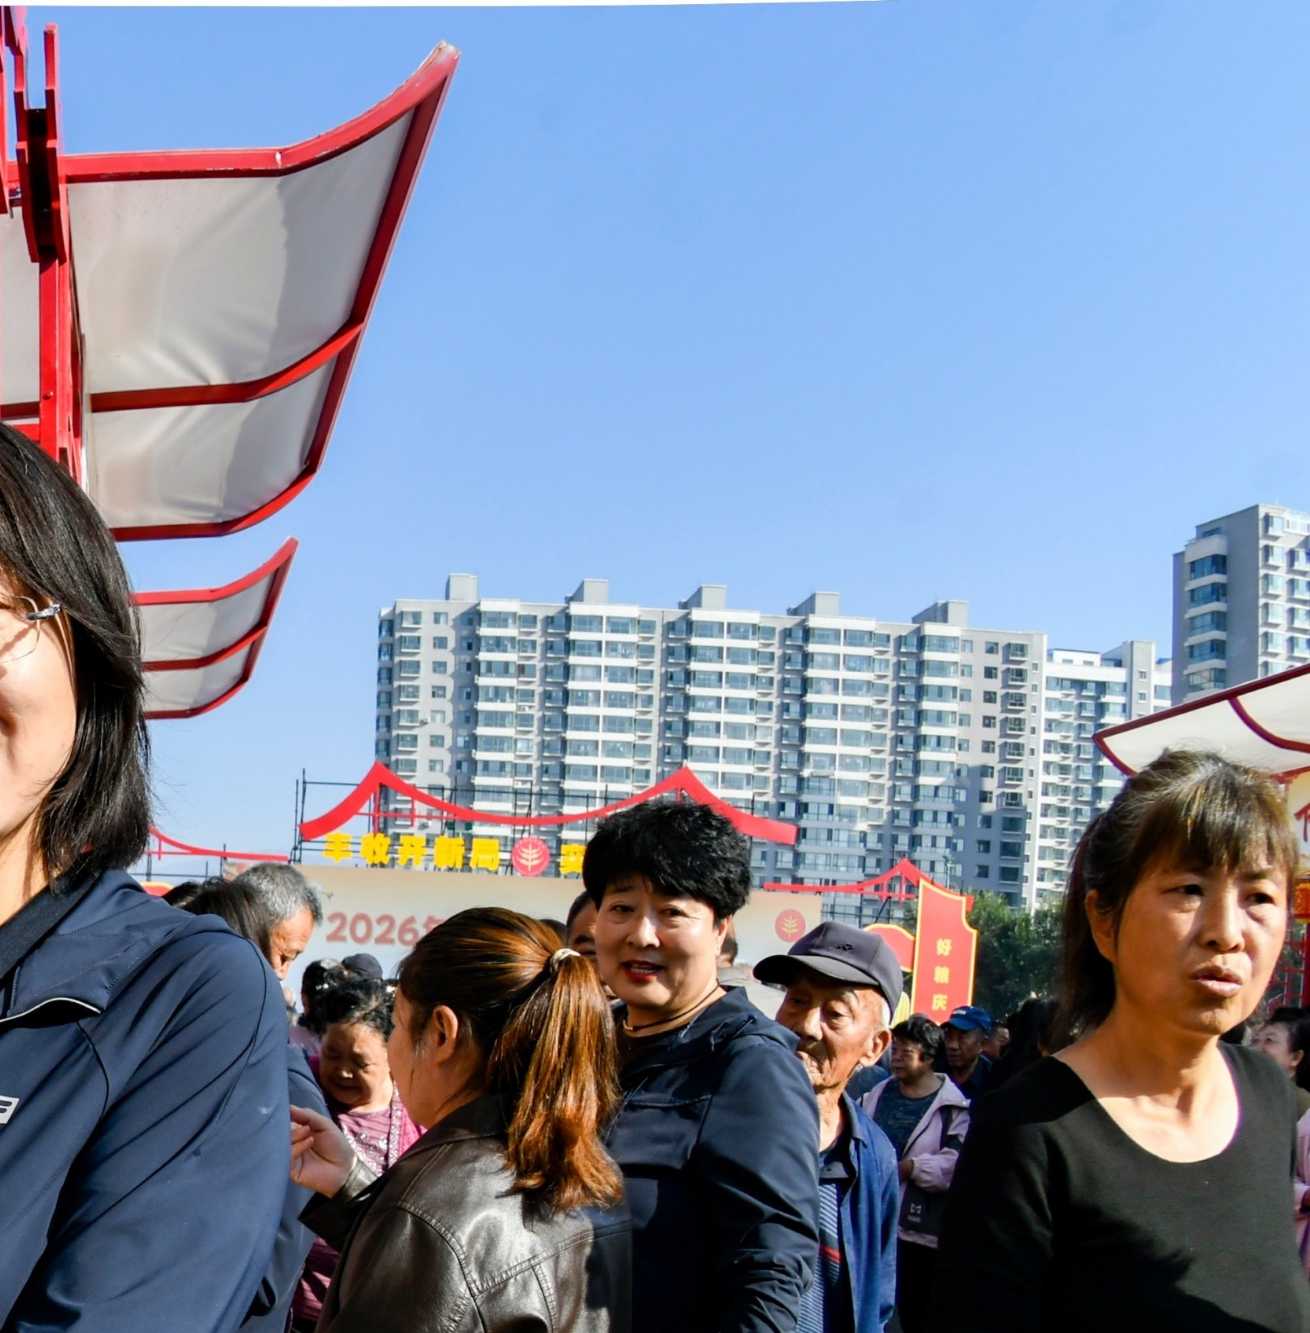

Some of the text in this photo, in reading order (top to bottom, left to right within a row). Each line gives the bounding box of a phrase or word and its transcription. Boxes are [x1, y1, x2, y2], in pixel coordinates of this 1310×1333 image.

[323, 832, 501, 872] 丰收开新局
